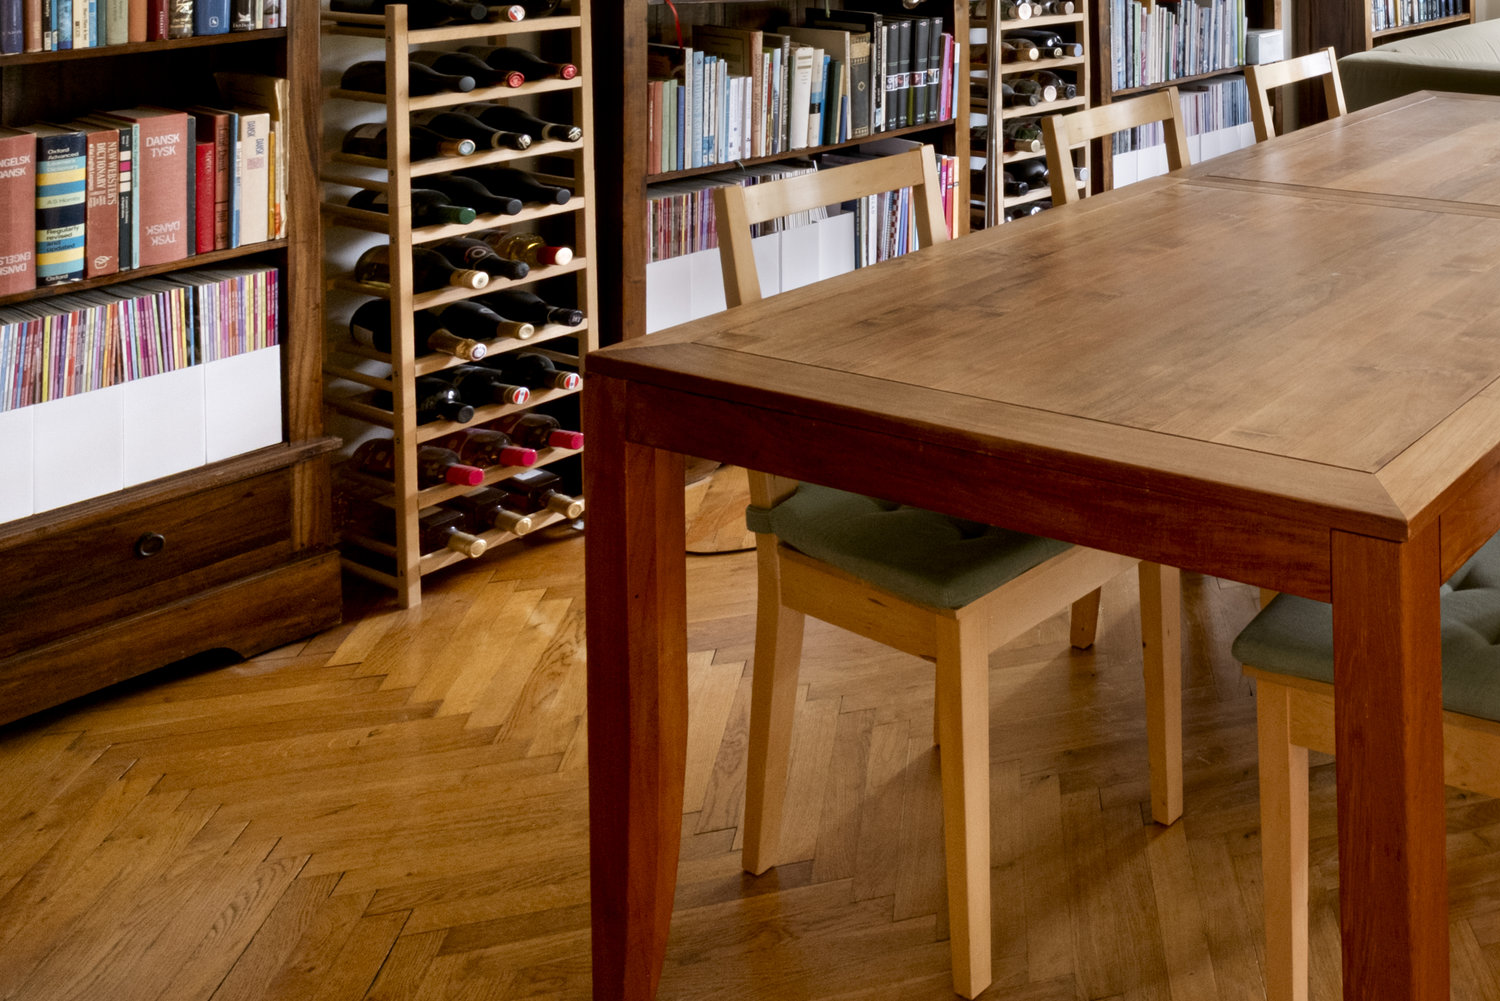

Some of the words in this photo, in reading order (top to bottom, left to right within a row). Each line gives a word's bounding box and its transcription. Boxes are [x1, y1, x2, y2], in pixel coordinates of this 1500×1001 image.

[247, 120, 256, 138] DANSK
[145, 133, 181, 146] DANSK
[48, 147, 70, 155] Oxford
[107, 142, 118, 160] NEW
[152, 145, 177, 158] TYSK
[256, 138, 264, 155] DANSK
[48, 152, 80, 160] Advanced
[96, 142, 107, 189] DICTIONARY
[107, 160, 118, 205] WEBSTER'S
[46, 225, 79, 236] Regularly
[145, 220, 181, 236] DANSK
[46, 232, 73, 241] revised
[150, 233, 177, 246] TYSK
[46, 243, 76, 252] updated
[0, 263, 27, 276] DANS
[45, 273, 69, 282] Oxford
